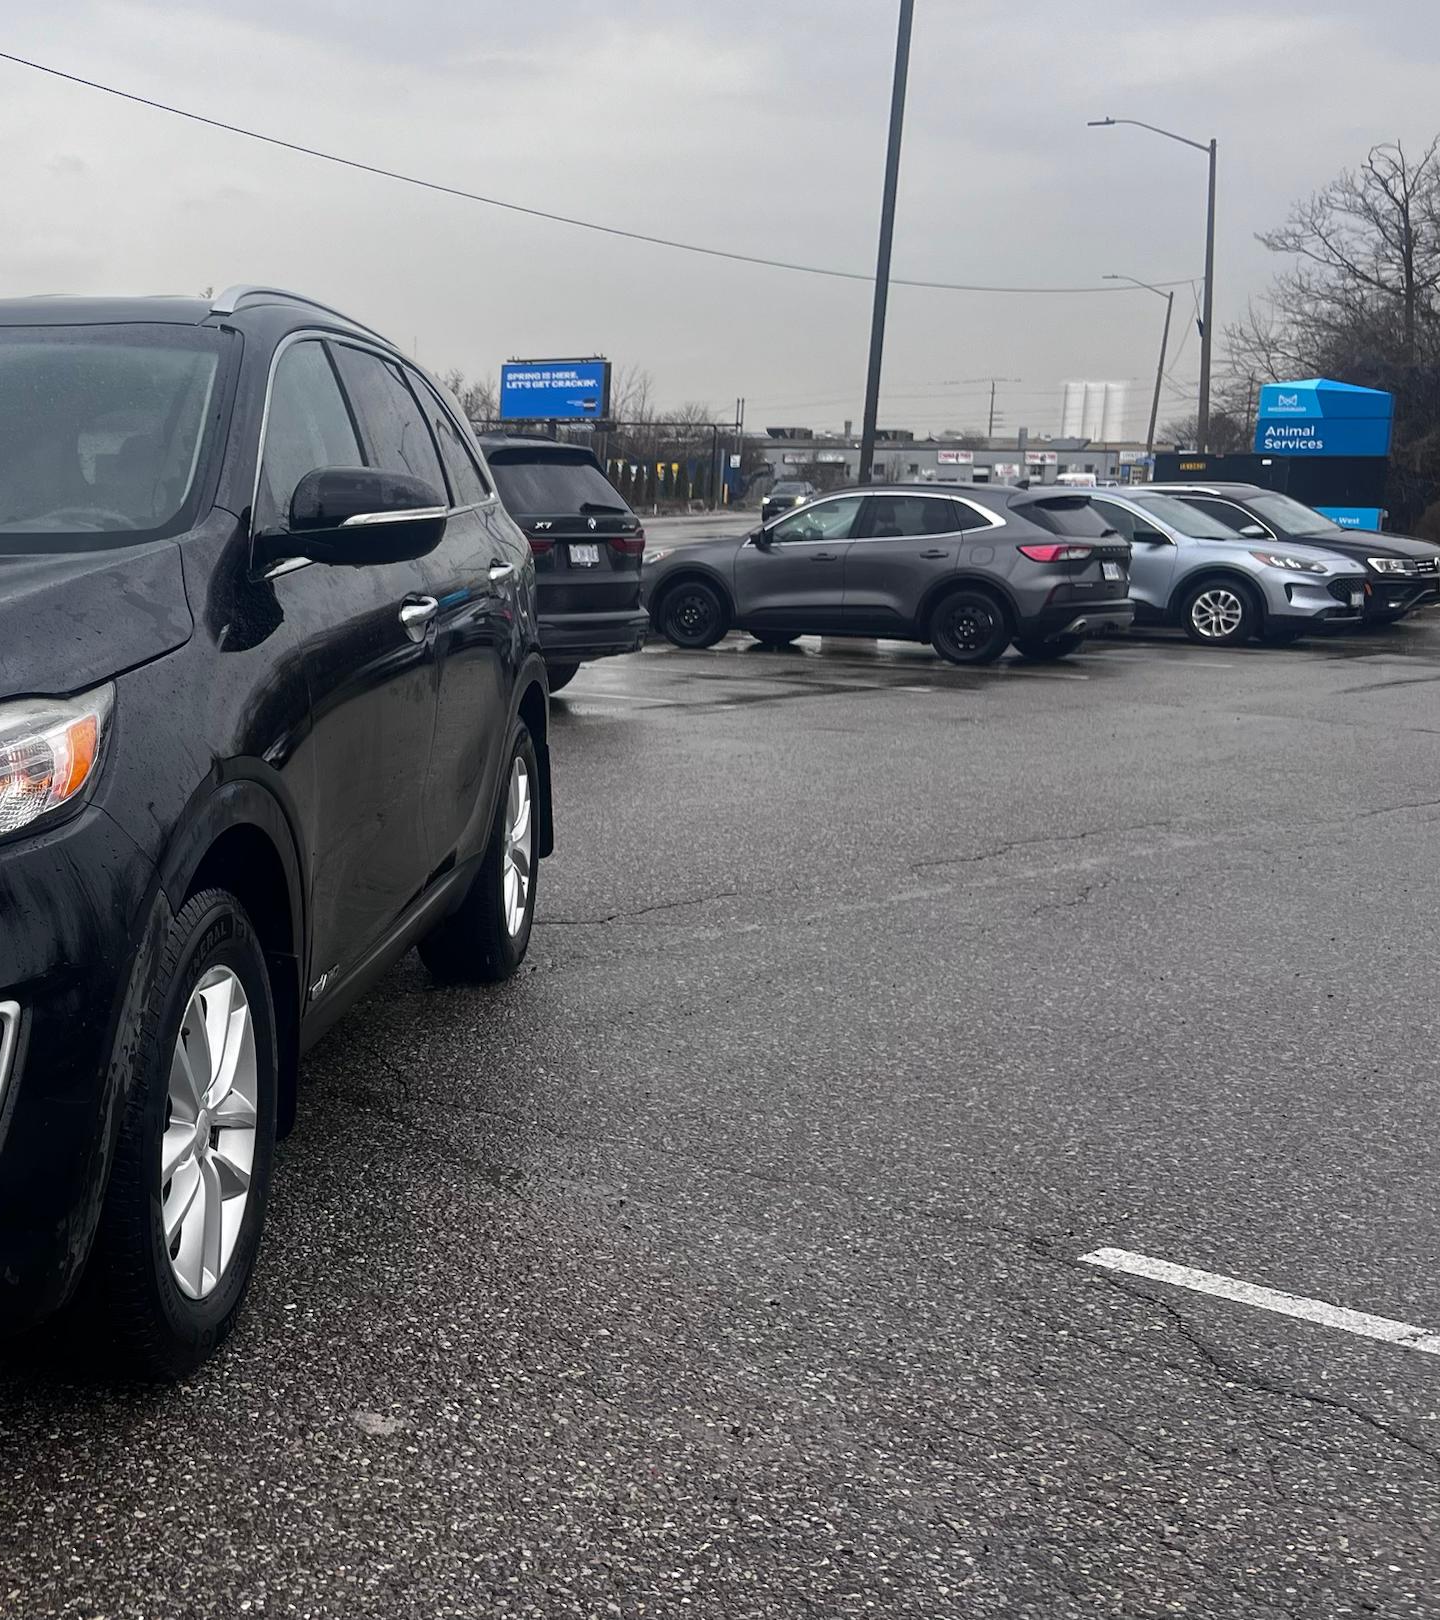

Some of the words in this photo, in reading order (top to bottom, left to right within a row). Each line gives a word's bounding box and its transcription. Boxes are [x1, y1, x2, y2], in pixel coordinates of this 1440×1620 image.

[507, 372, 541, 381] SPRING
[542, 372, 551, 380] IS
[506, 380, 531, 389] LET'S
[532, 380, 551, 389] GET
[1265, 425, 1314, 437] Animal
[1264, 438, 1323, 450] Services
[1339, 516, 1360, 525] West
